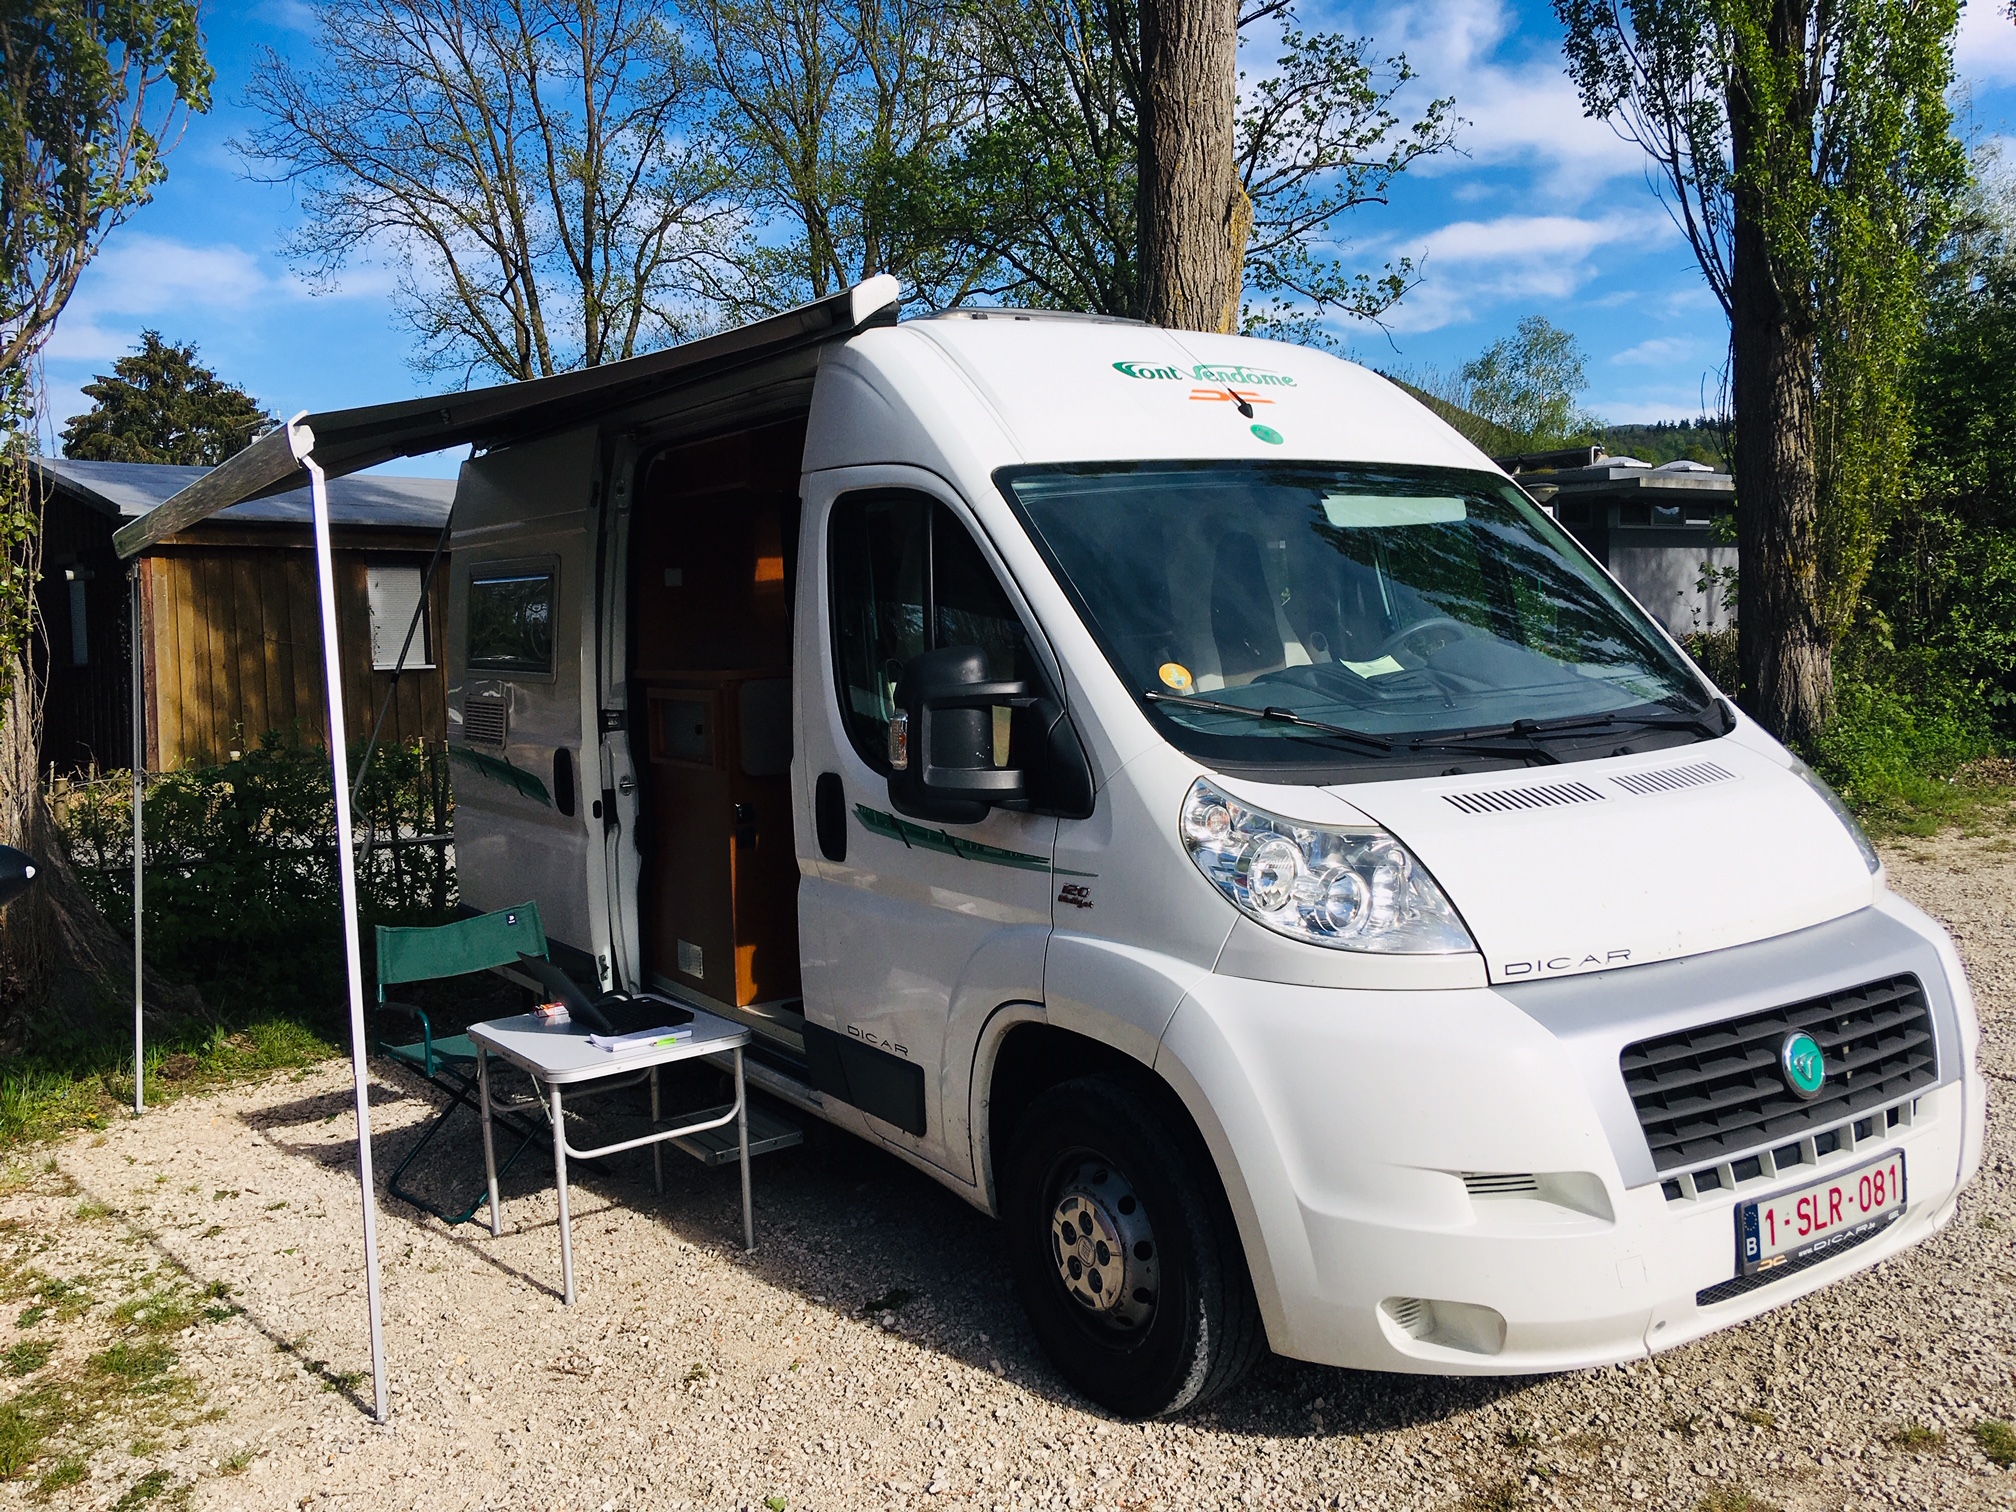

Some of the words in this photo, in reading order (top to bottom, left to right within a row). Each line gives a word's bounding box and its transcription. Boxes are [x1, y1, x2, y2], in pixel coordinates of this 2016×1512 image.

[1504, 949, 1631, 975] DICAR
[847, 1024, 909, 1056] DICAR
[1765, 1164, 1897, 1246] 1-SLR-081
[1746, 1237, 1758, 1256] B
